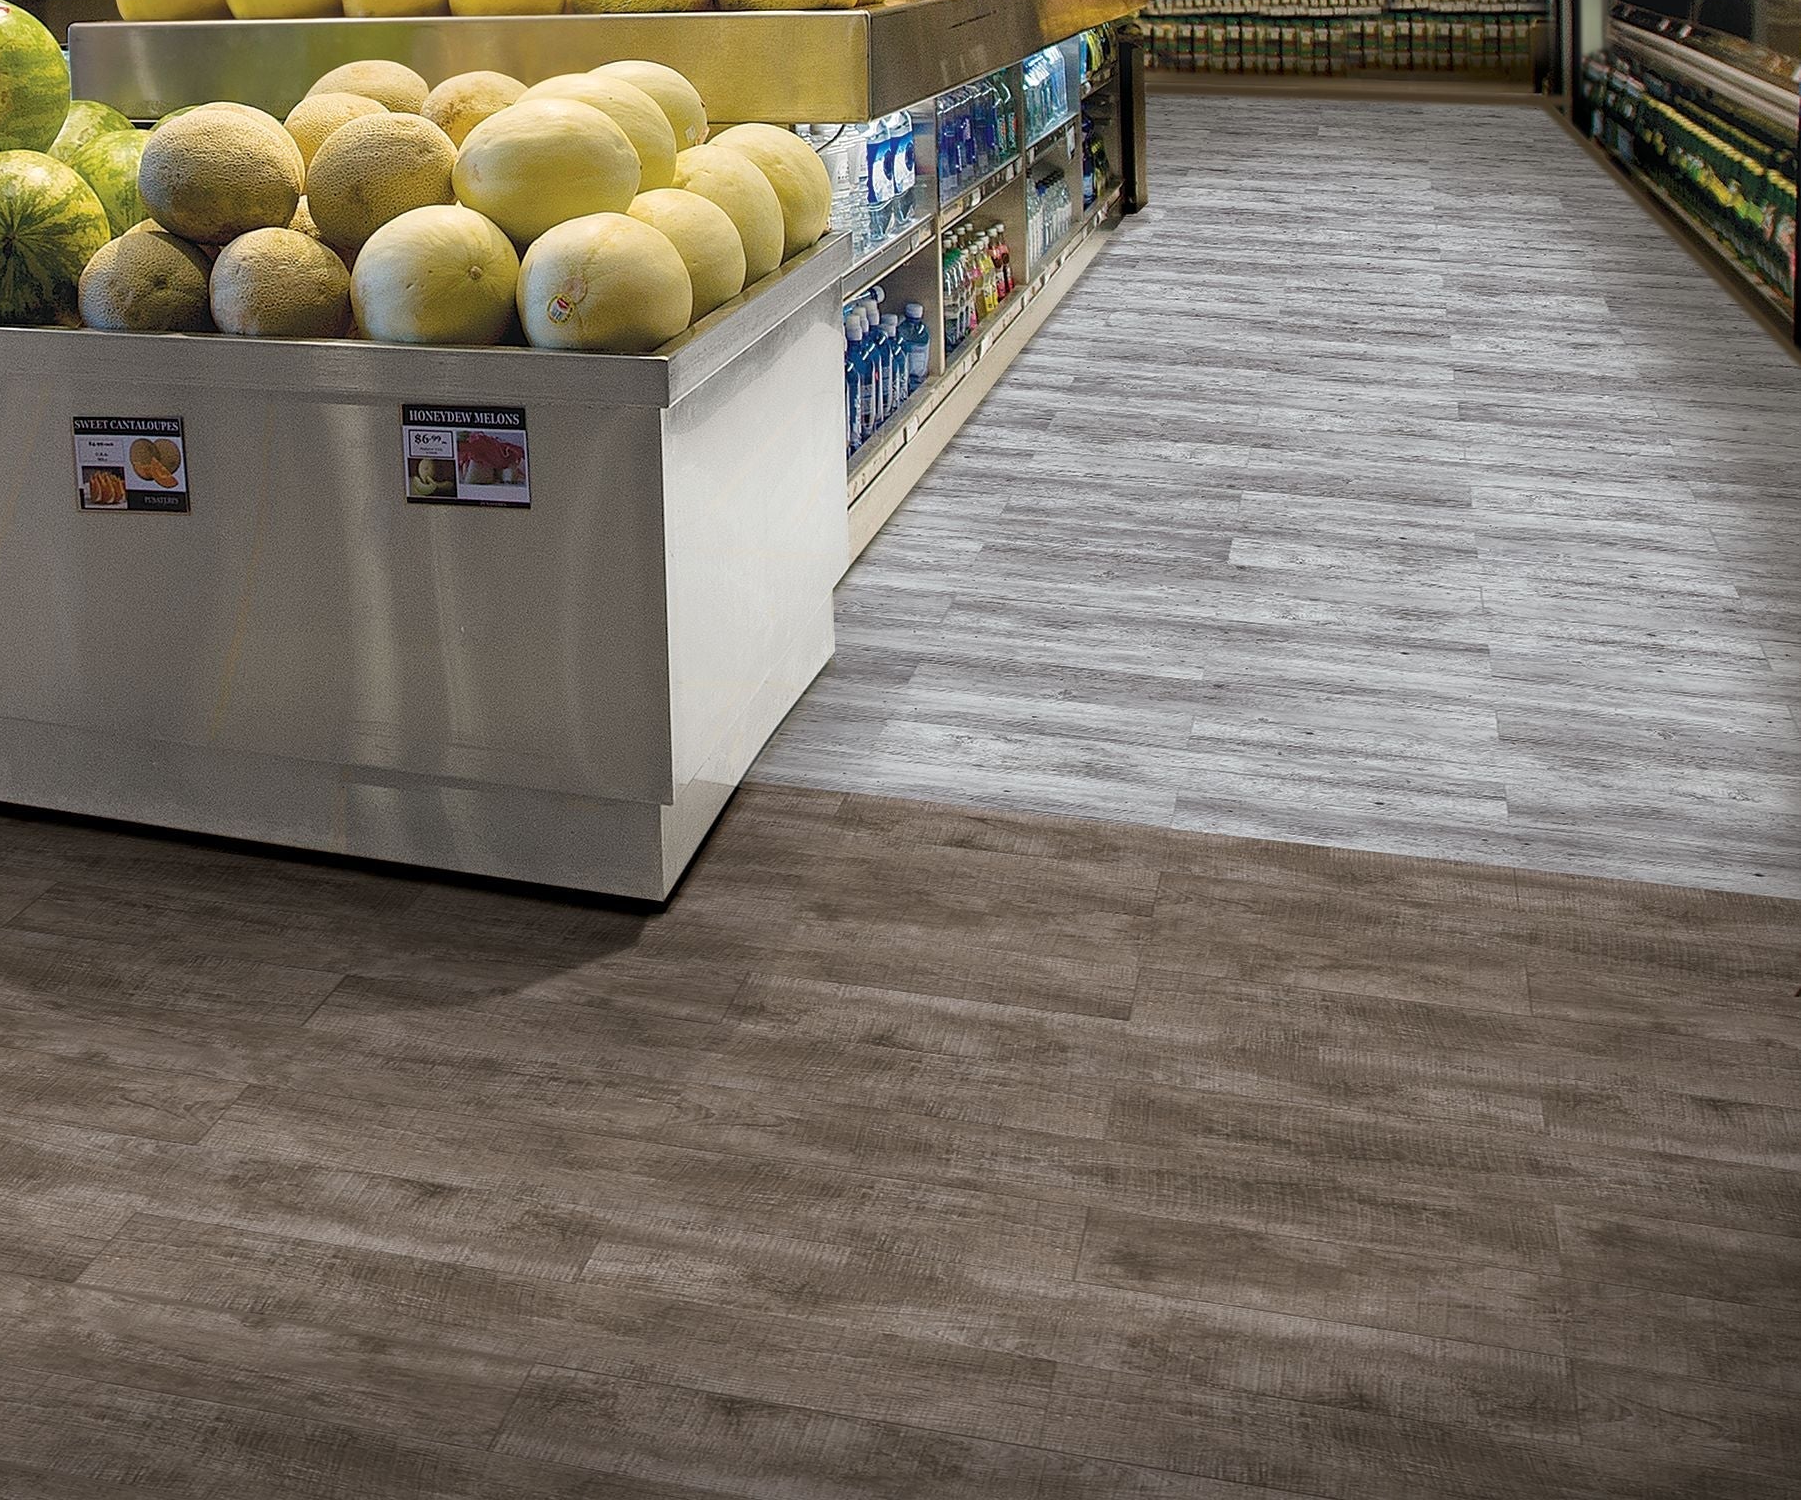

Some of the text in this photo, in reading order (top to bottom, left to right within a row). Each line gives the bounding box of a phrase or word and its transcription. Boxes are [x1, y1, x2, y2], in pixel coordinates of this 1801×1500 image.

[409, 409, 520, 425] HONEYDEW MELONS
[74, 419, 179, 431] SWEET CANTALOUPES
